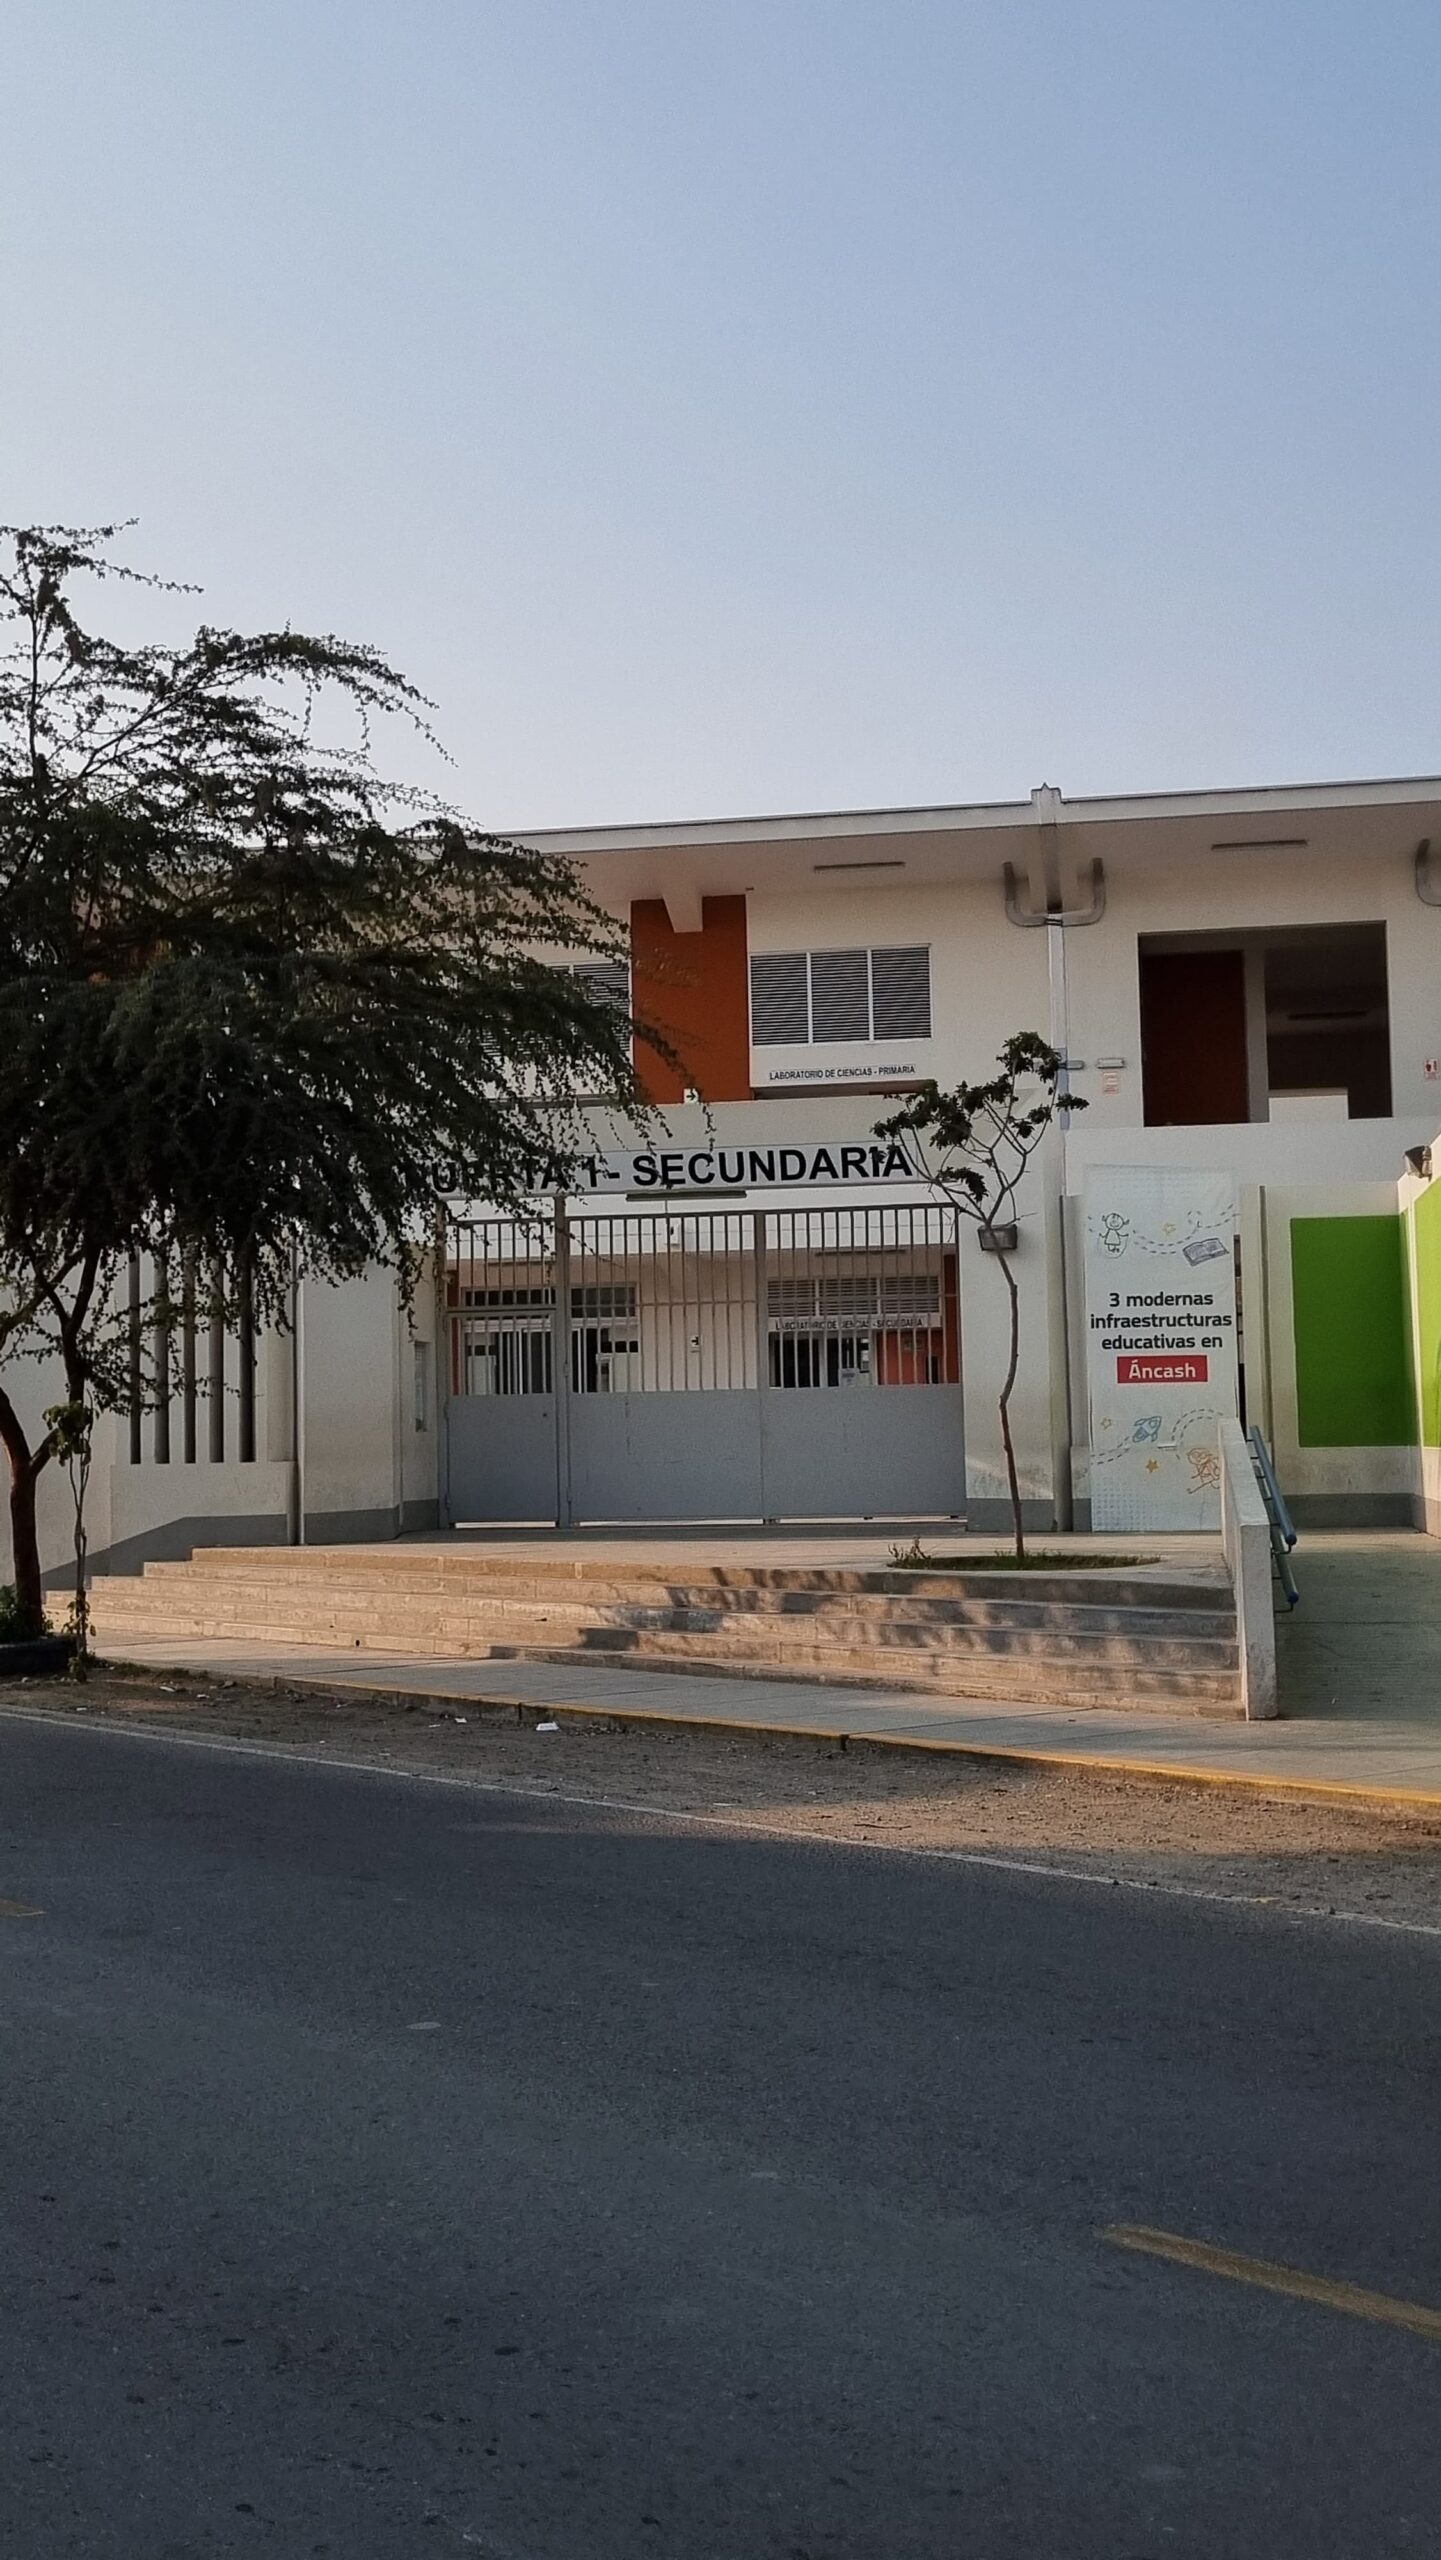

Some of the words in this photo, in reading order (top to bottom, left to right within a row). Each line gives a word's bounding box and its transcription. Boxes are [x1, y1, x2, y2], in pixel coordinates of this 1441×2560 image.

[769, 1070, 823, 1081] LABORATORIO
[825, 1069, 836, 1079] DE
[837, 1067, 872, 1078] CIENCIAS
[878, 1065, 915, 1076] PRIMARIA
[632, 1146, 913, 1187] SECUNDARIA
[1109, 1292, 1120, 1307] 3
[1126, 1291, 1213, 1307] modernas
[1090, 1313, 1232, 1329] infraestructuras
[1102, 1334, 1195, 1349] educativas
[1201, 1336, 1223, 1348] en
[1129, 1359, 1196, 1379] Áncash
